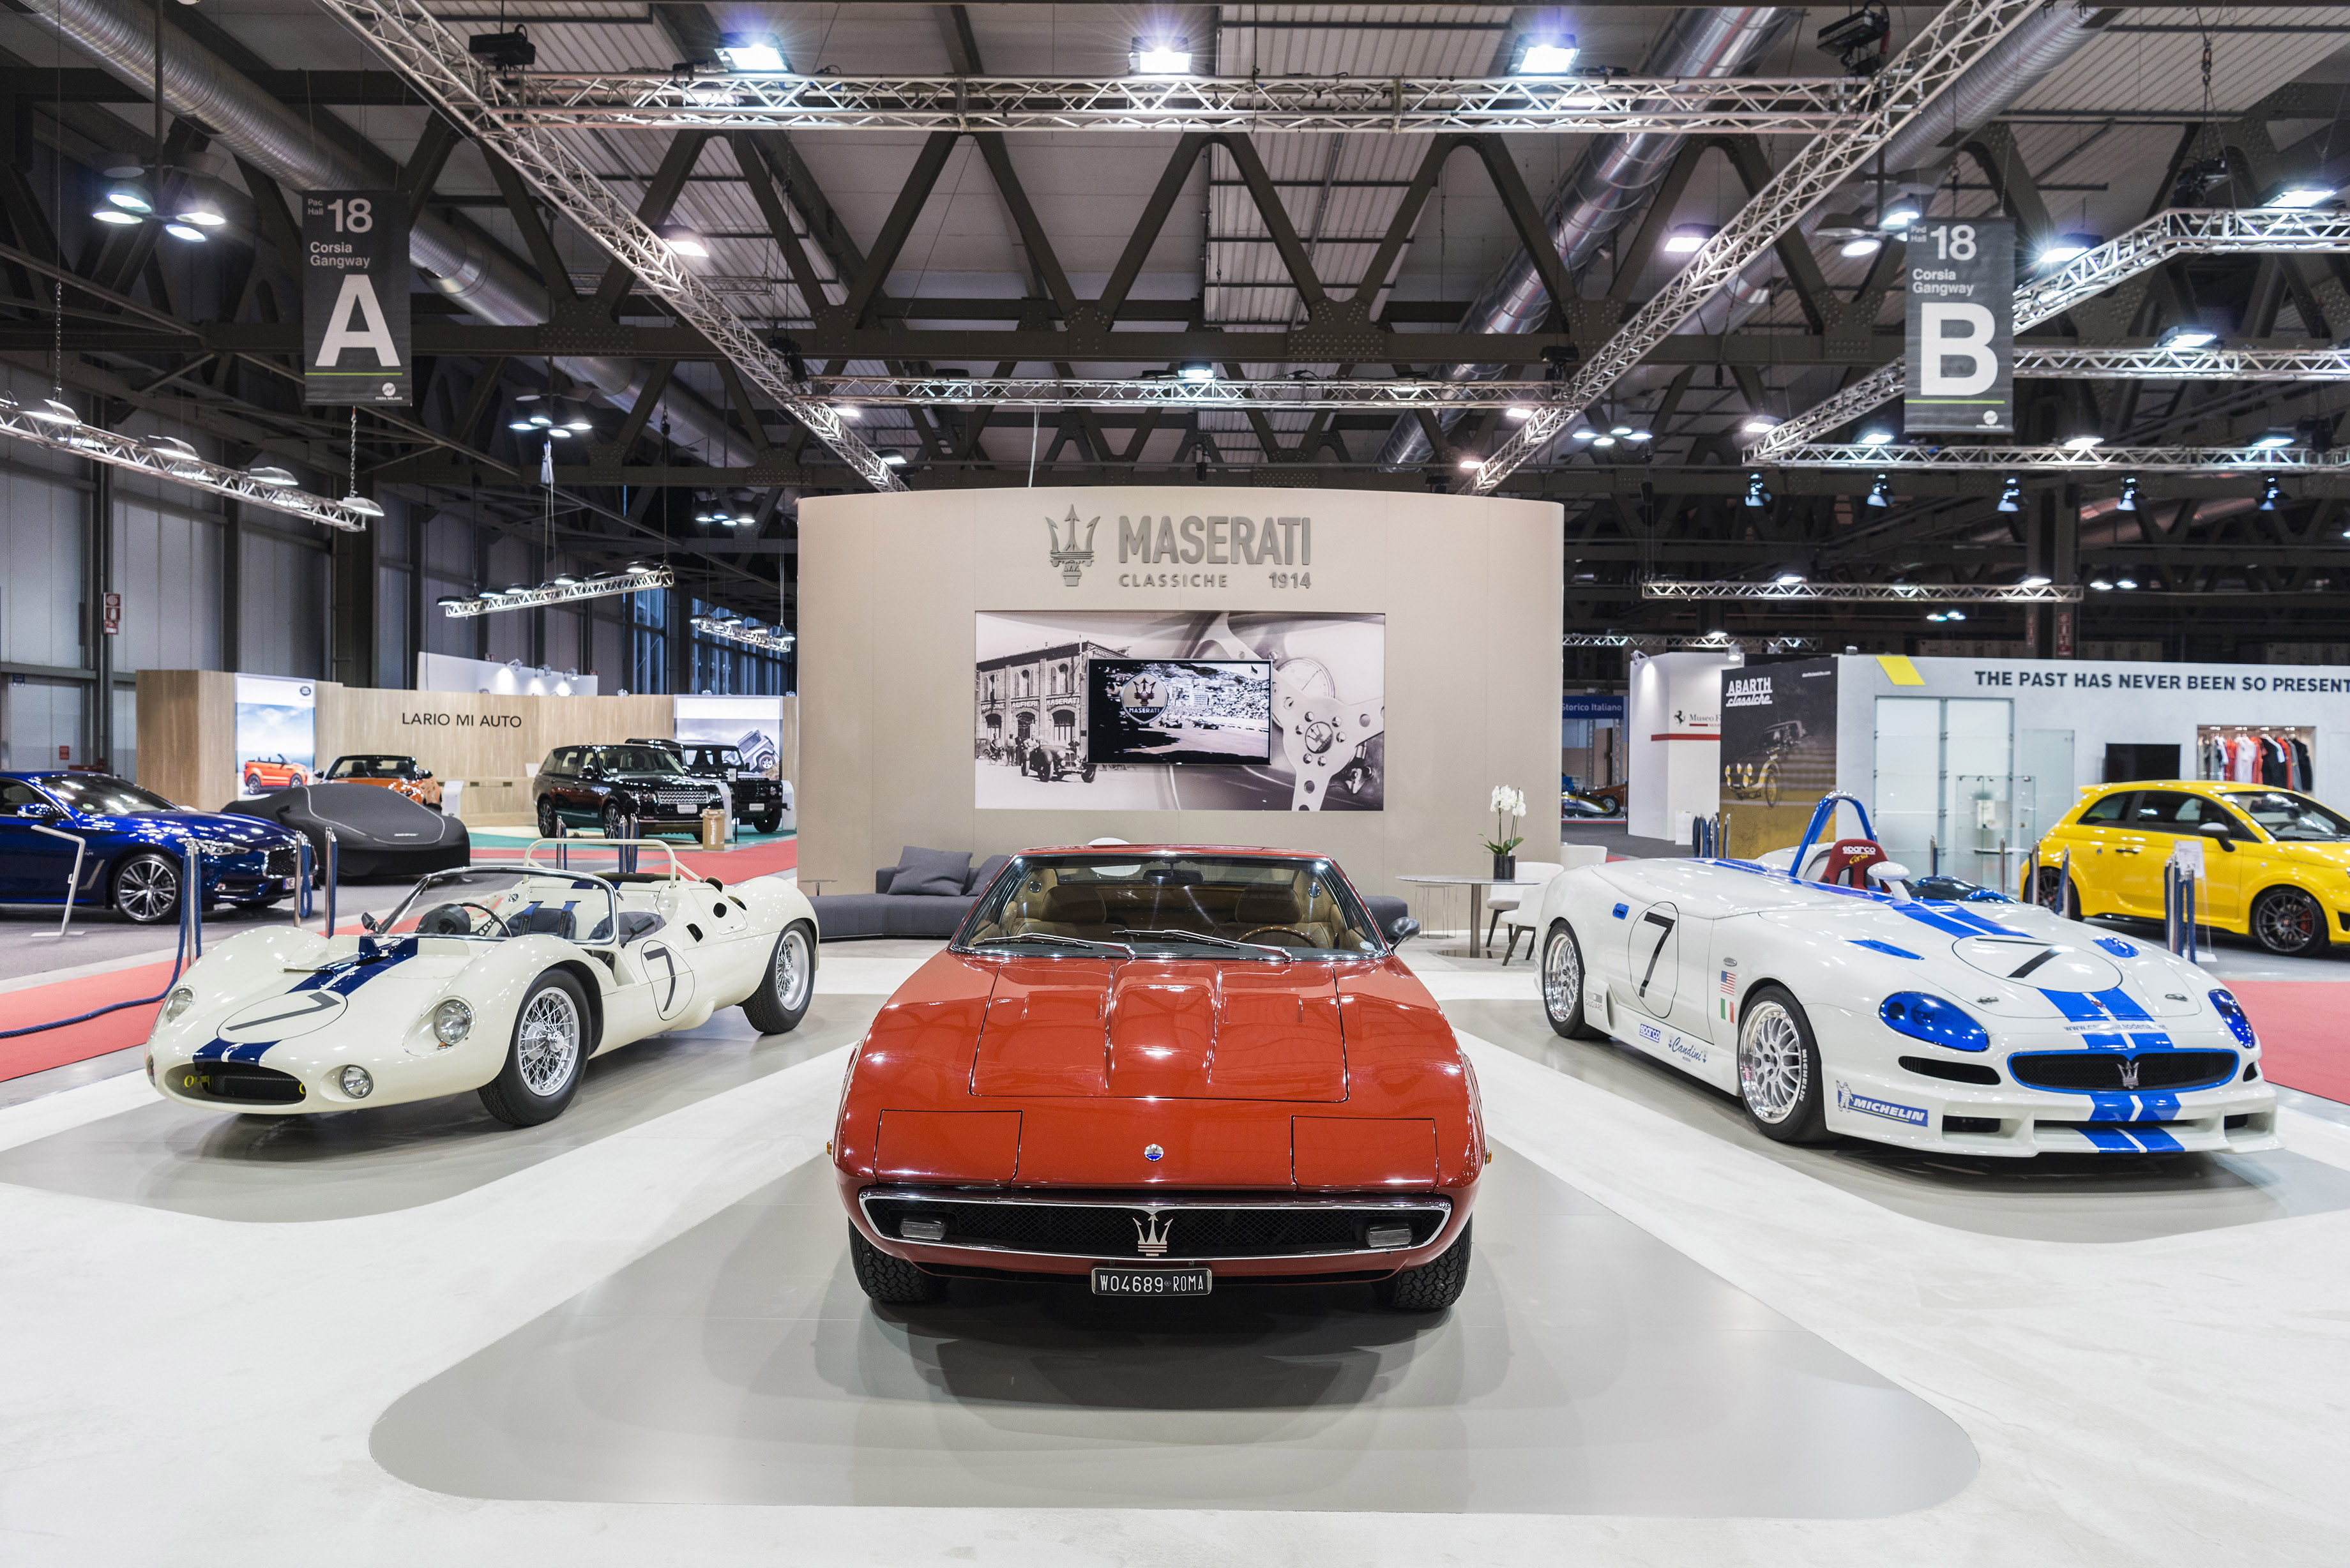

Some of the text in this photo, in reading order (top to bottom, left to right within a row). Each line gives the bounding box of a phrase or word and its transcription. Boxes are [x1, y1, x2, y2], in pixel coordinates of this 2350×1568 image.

[327, 198, 373, 234] 18
[310, 241, 352, 253] Corsia
[1910, 234, 1927, 243] Hall
[1930, 225, 1977, 261] 18
[310, 255, 370, 269] Gangway
[1912, 268, 1957, 281] Corsia
[1912, 282, 1975, 297] Gangway
[315, 275, 401, 366] A
[1921, 302, 1998, 396] B
[1118, 515, 1311, 565] MASERATI
[1118, 571, 1312, 589] CLASSICHE 1914
[1727, 677, 1771, 694] ABARTH
[1975, 671, 2350, 693] THE PAST HAS NEVER BEEN SO PRESENT
[1046, 697, 1080, 706] MASERATI
[1562, 703, 1622, 711] Storico Italiano
[1727, 692, 1771, 706] classiche
[402, 712, 522, 728] LARIO MI AUTO
[1842, 846, 1876, 854] sparco
[1639, 911, 1676, 998] 7
[1975, 938, 2070, 978] 7
[643, 947, 676, 1013] 7
[225, 991, 341, 1031] 7
[1639, 1024, 1660, 1041] sparco
[1671, 1037, 1703, 1061] Candini
[1799, 1049, 1808, 1101] MICHELIN
[1853, 1098, 1925, 1122] MICHELIN
[1172, 1275, 1204, 1292] ROMA
